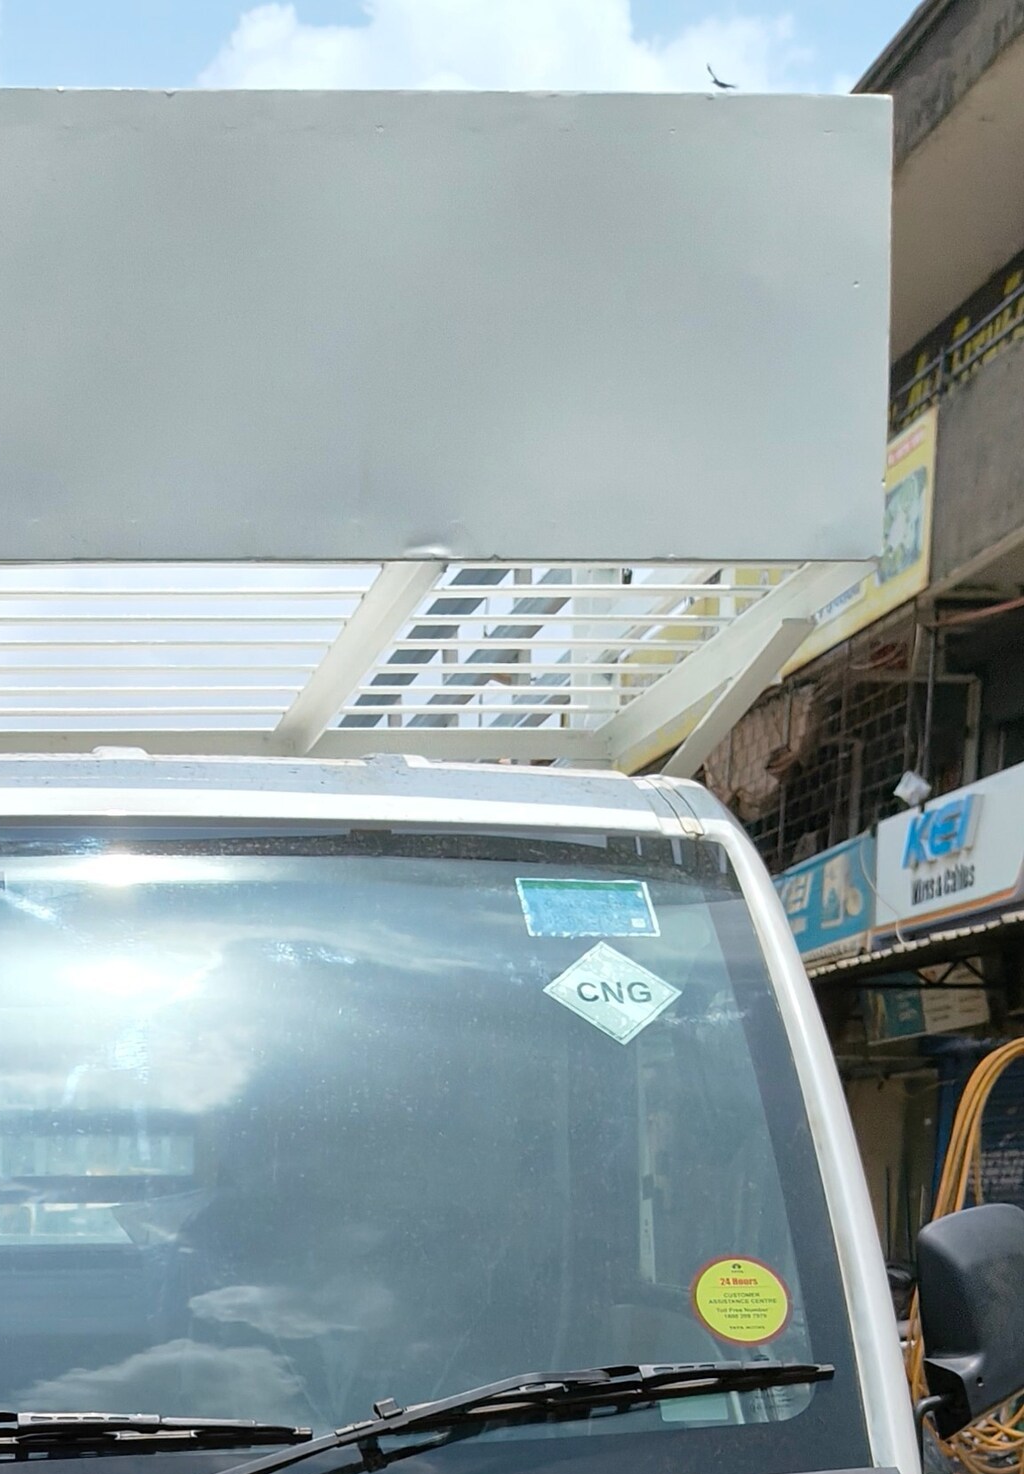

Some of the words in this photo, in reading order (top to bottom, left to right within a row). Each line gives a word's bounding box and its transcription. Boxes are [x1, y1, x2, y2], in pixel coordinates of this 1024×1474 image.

[902, 794, 976, 868] KEI
[576, 981, 653, 1004] CNG
[720, 1277, 731, 1286] 24
[732, 1277, 758, 1285] Hours
